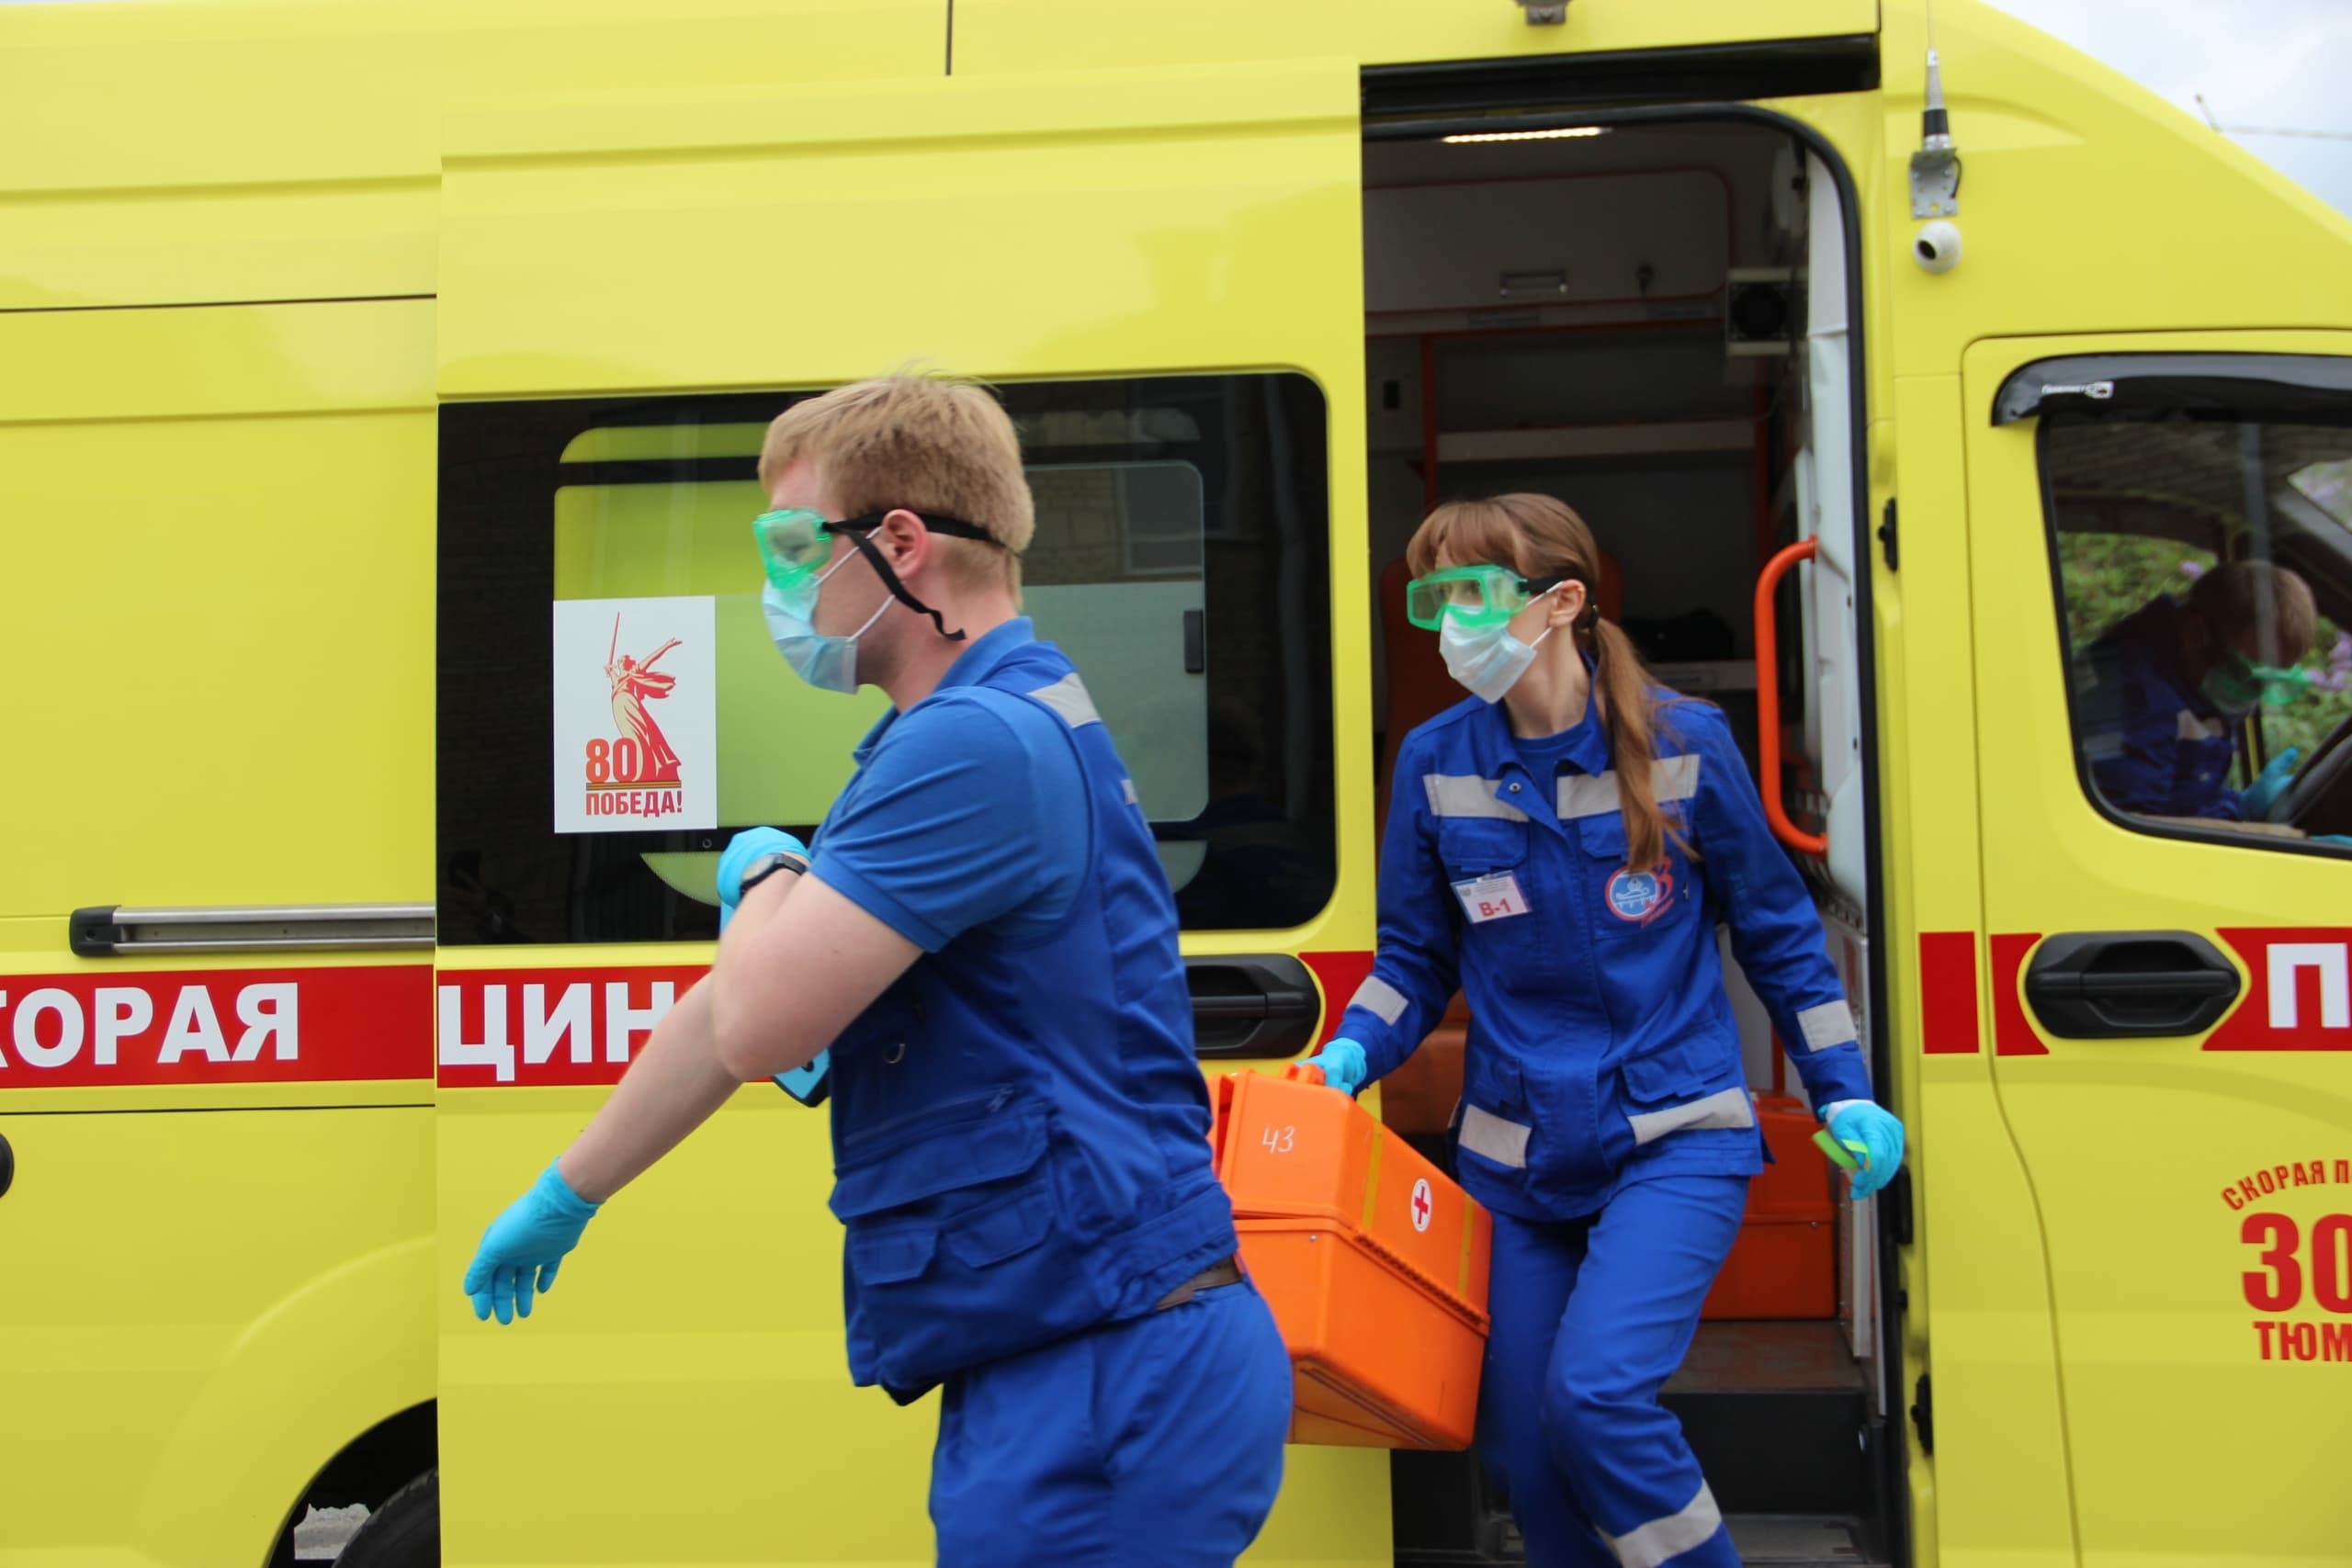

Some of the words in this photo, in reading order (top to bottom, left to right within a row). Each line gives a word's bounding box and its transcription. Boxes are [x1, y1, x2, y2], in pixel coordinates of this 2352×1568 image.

[585, 738, 637, 784] 80
[585, 791, 682, 818] ПОБЕДА!
[2266, 942, 2350, 1028] П
[0, 982, 299, 1067] ОРАЯ
[1261, 1125, 1295, 1154] 43
[2221, 1160, 2325, 1211] СКОРАЯ
[2253, 1321, 2352, 1362] ТЮМ
